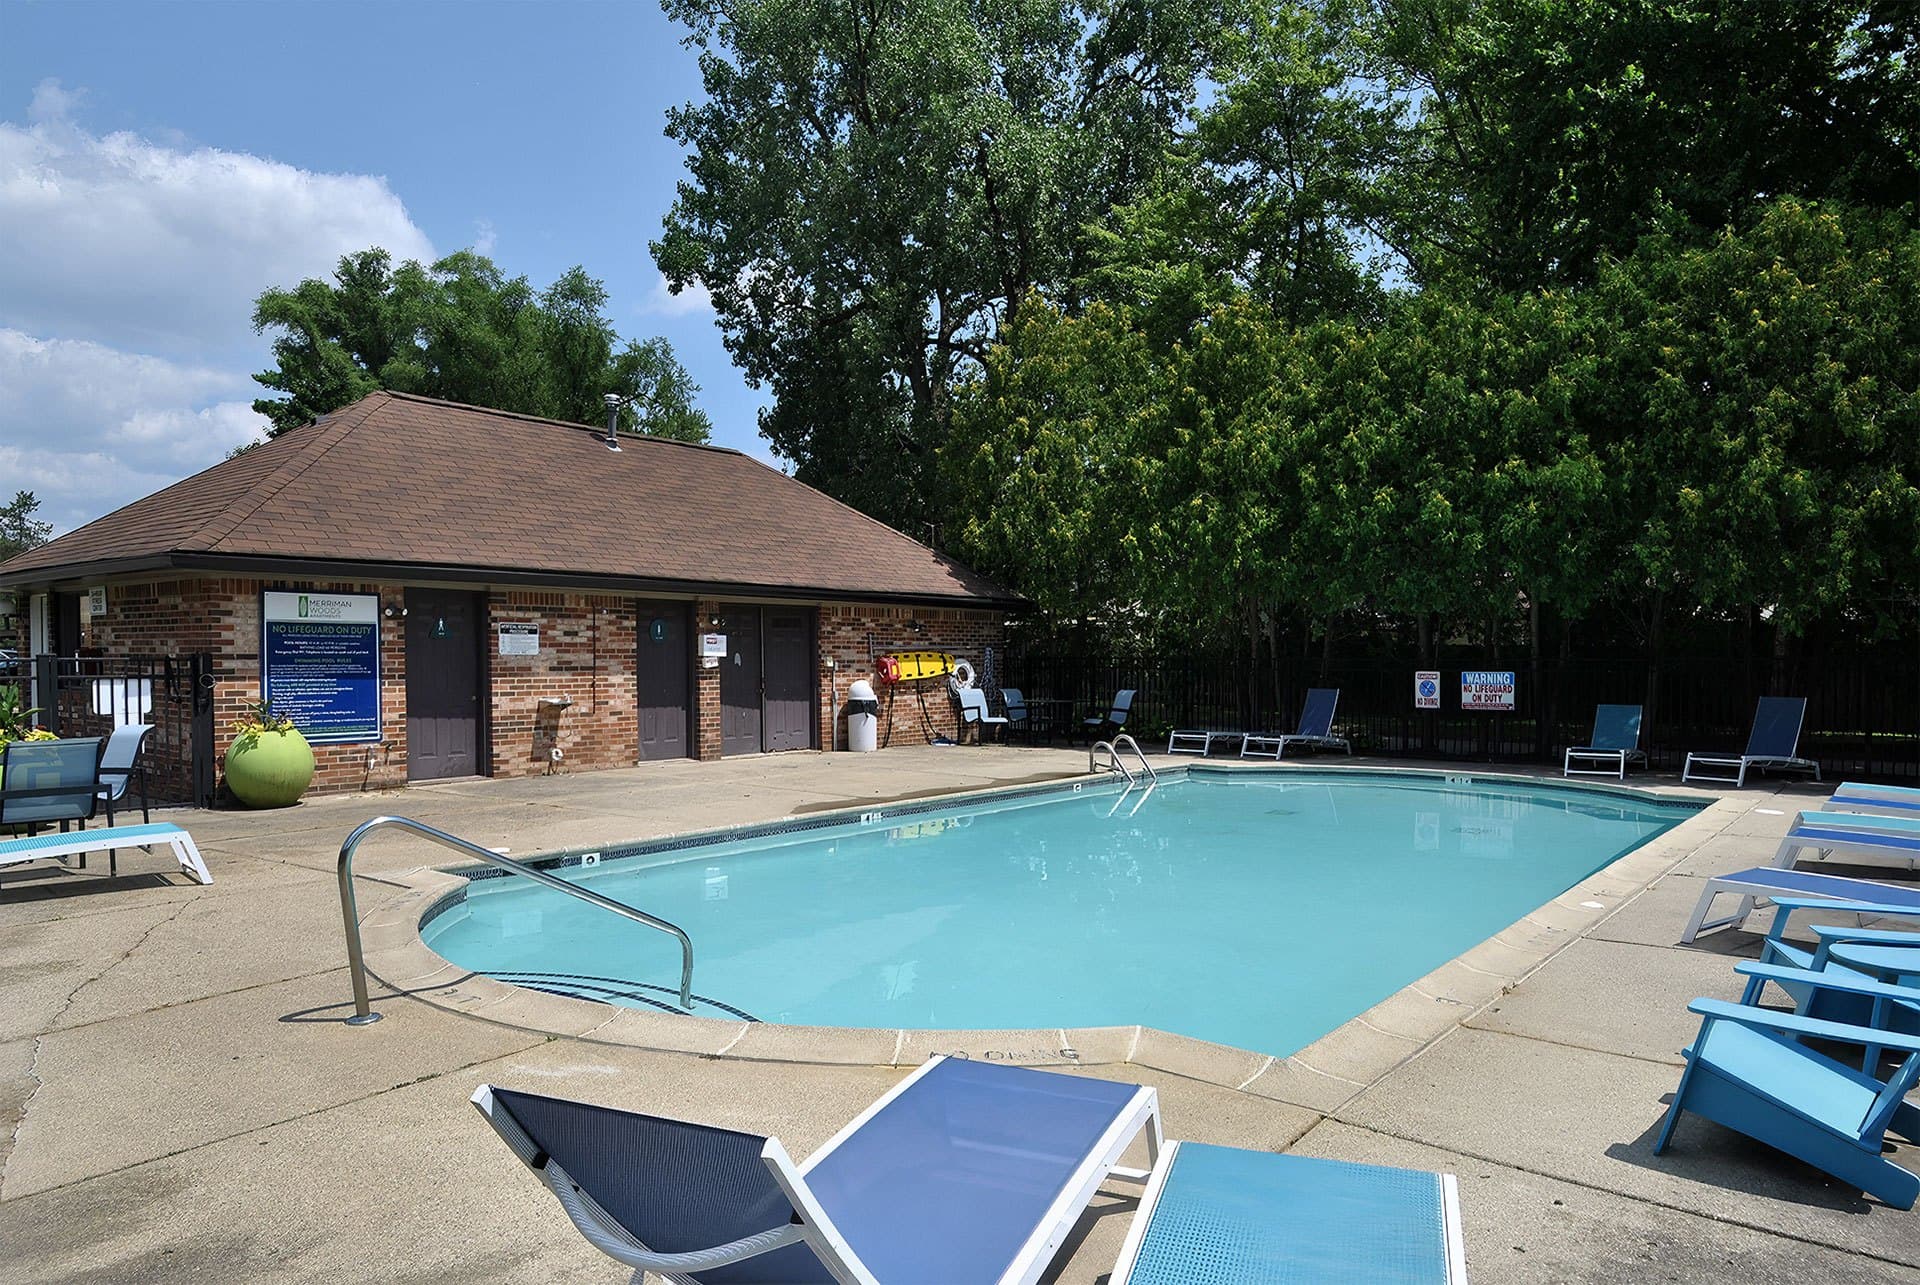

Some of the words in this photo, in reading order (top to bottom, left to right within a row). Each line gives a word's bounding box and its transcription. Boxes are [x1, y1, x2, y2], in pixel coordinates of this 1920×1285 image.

[309, 600, 352, 608] MERRIMAN
[309, 607, 342, 615] WOODS
[272, 625, 287, 633] NO
[288, 625, 334, 634] LIFEGUARD
[335, 626, 349, 634] ON
[351, 626, 372, 635] DUTY
[1466, 673, 1510, 685] WARNING
[1463, 685, 1473, 693] NO
[1475, 685, 1513, 694] LIFEGUARD
[1472, 694, 1482, 703] ON
[1484, 694, 1503, 703] DUTY
